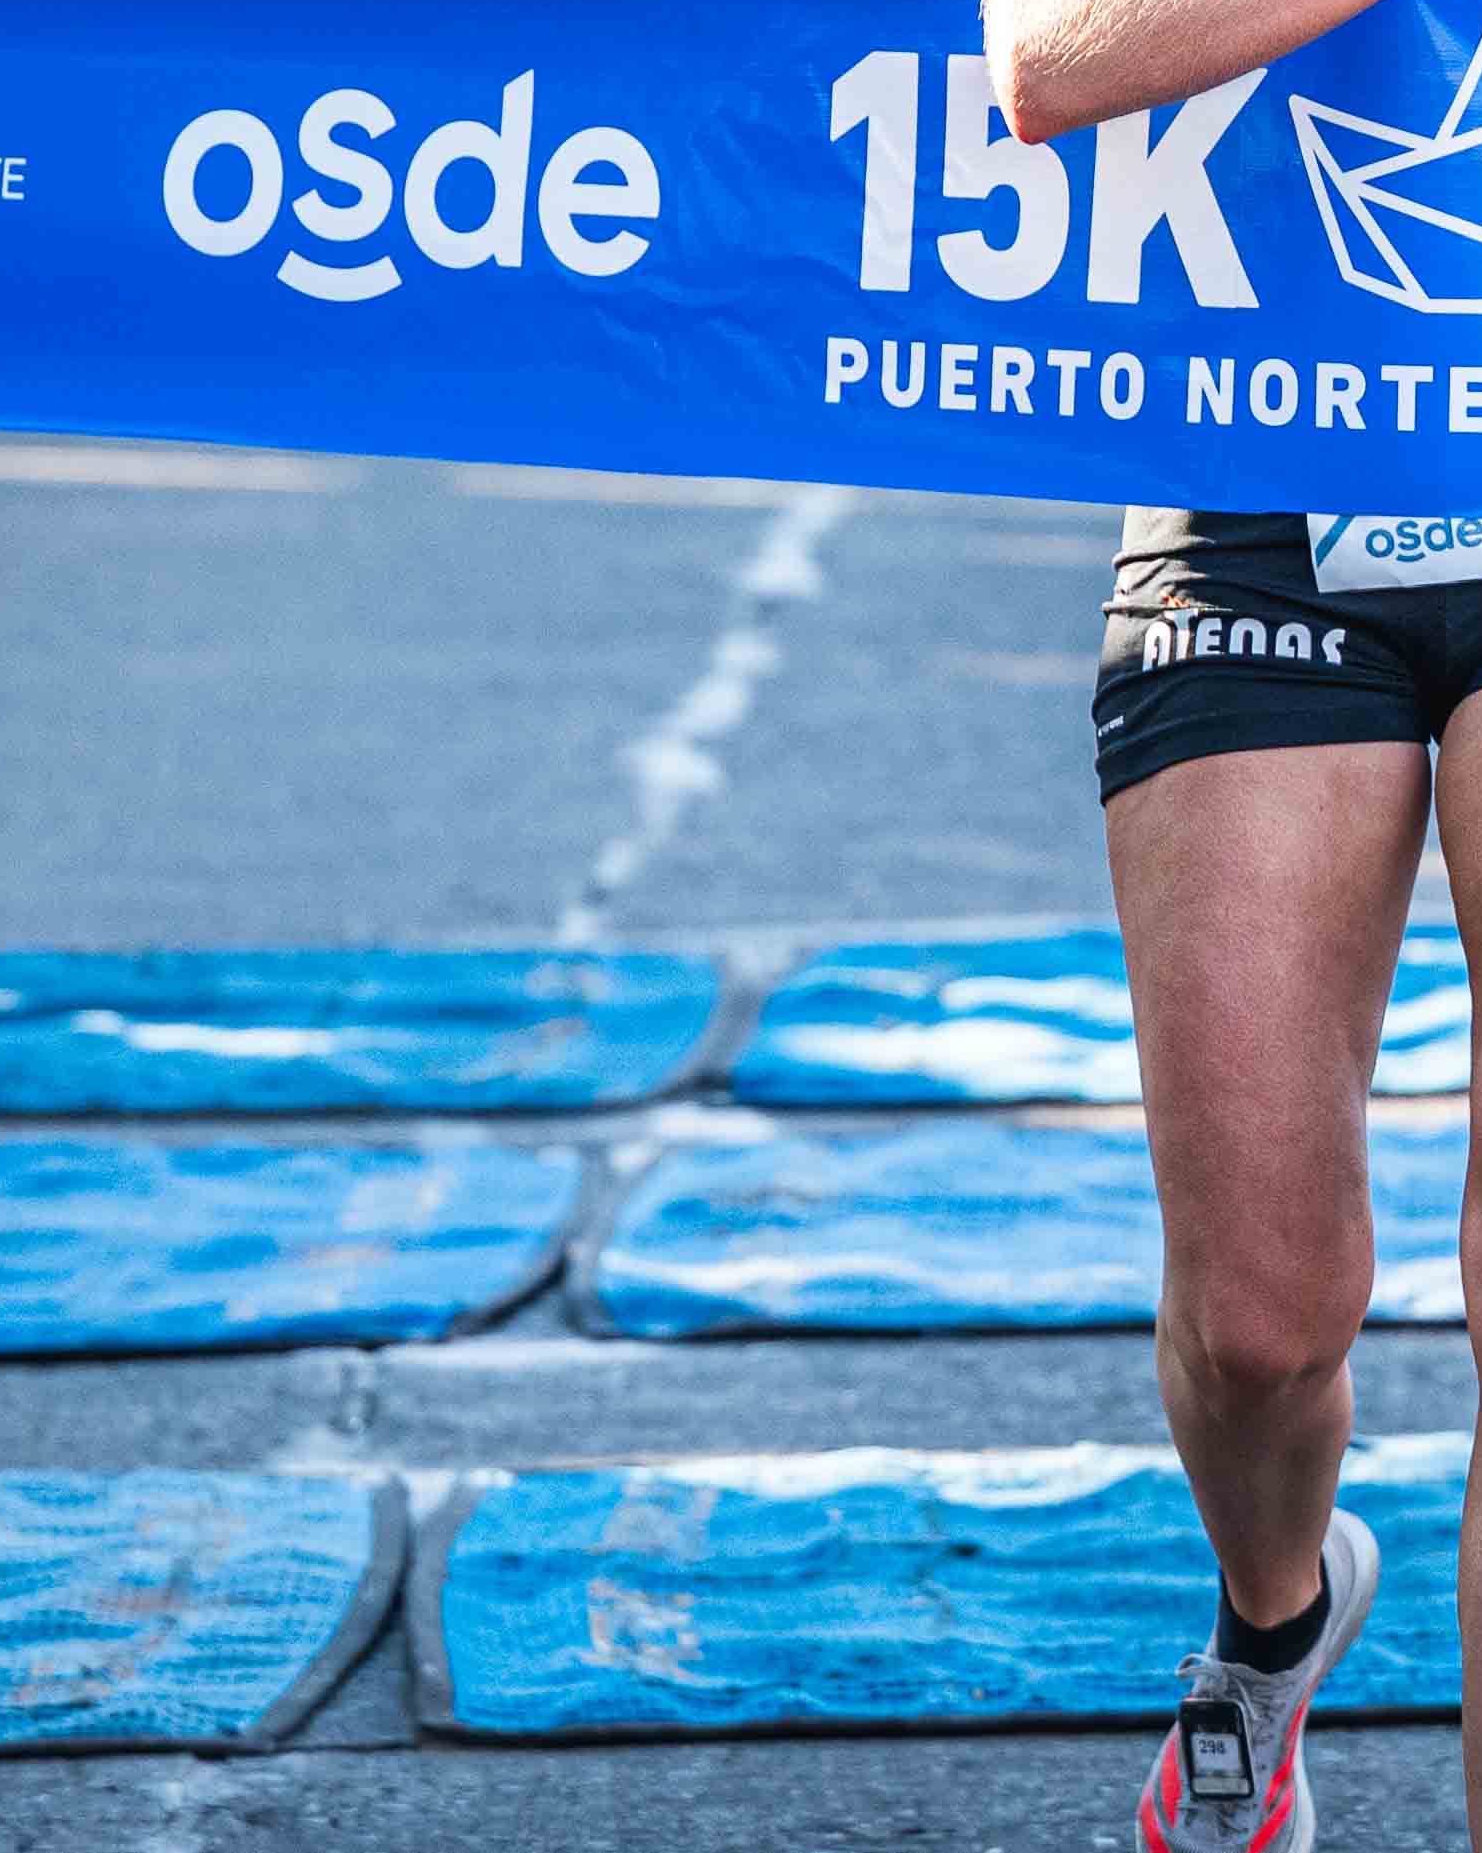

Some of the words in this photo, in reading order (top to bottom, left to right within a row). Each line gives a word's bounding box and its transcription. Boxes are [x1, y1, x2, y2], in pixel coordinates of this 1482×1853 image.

[163, 68, 661, 278] osde
[829, 51, 1268, 309] 15K
[824, 336, 1146, 420] PUERTO
